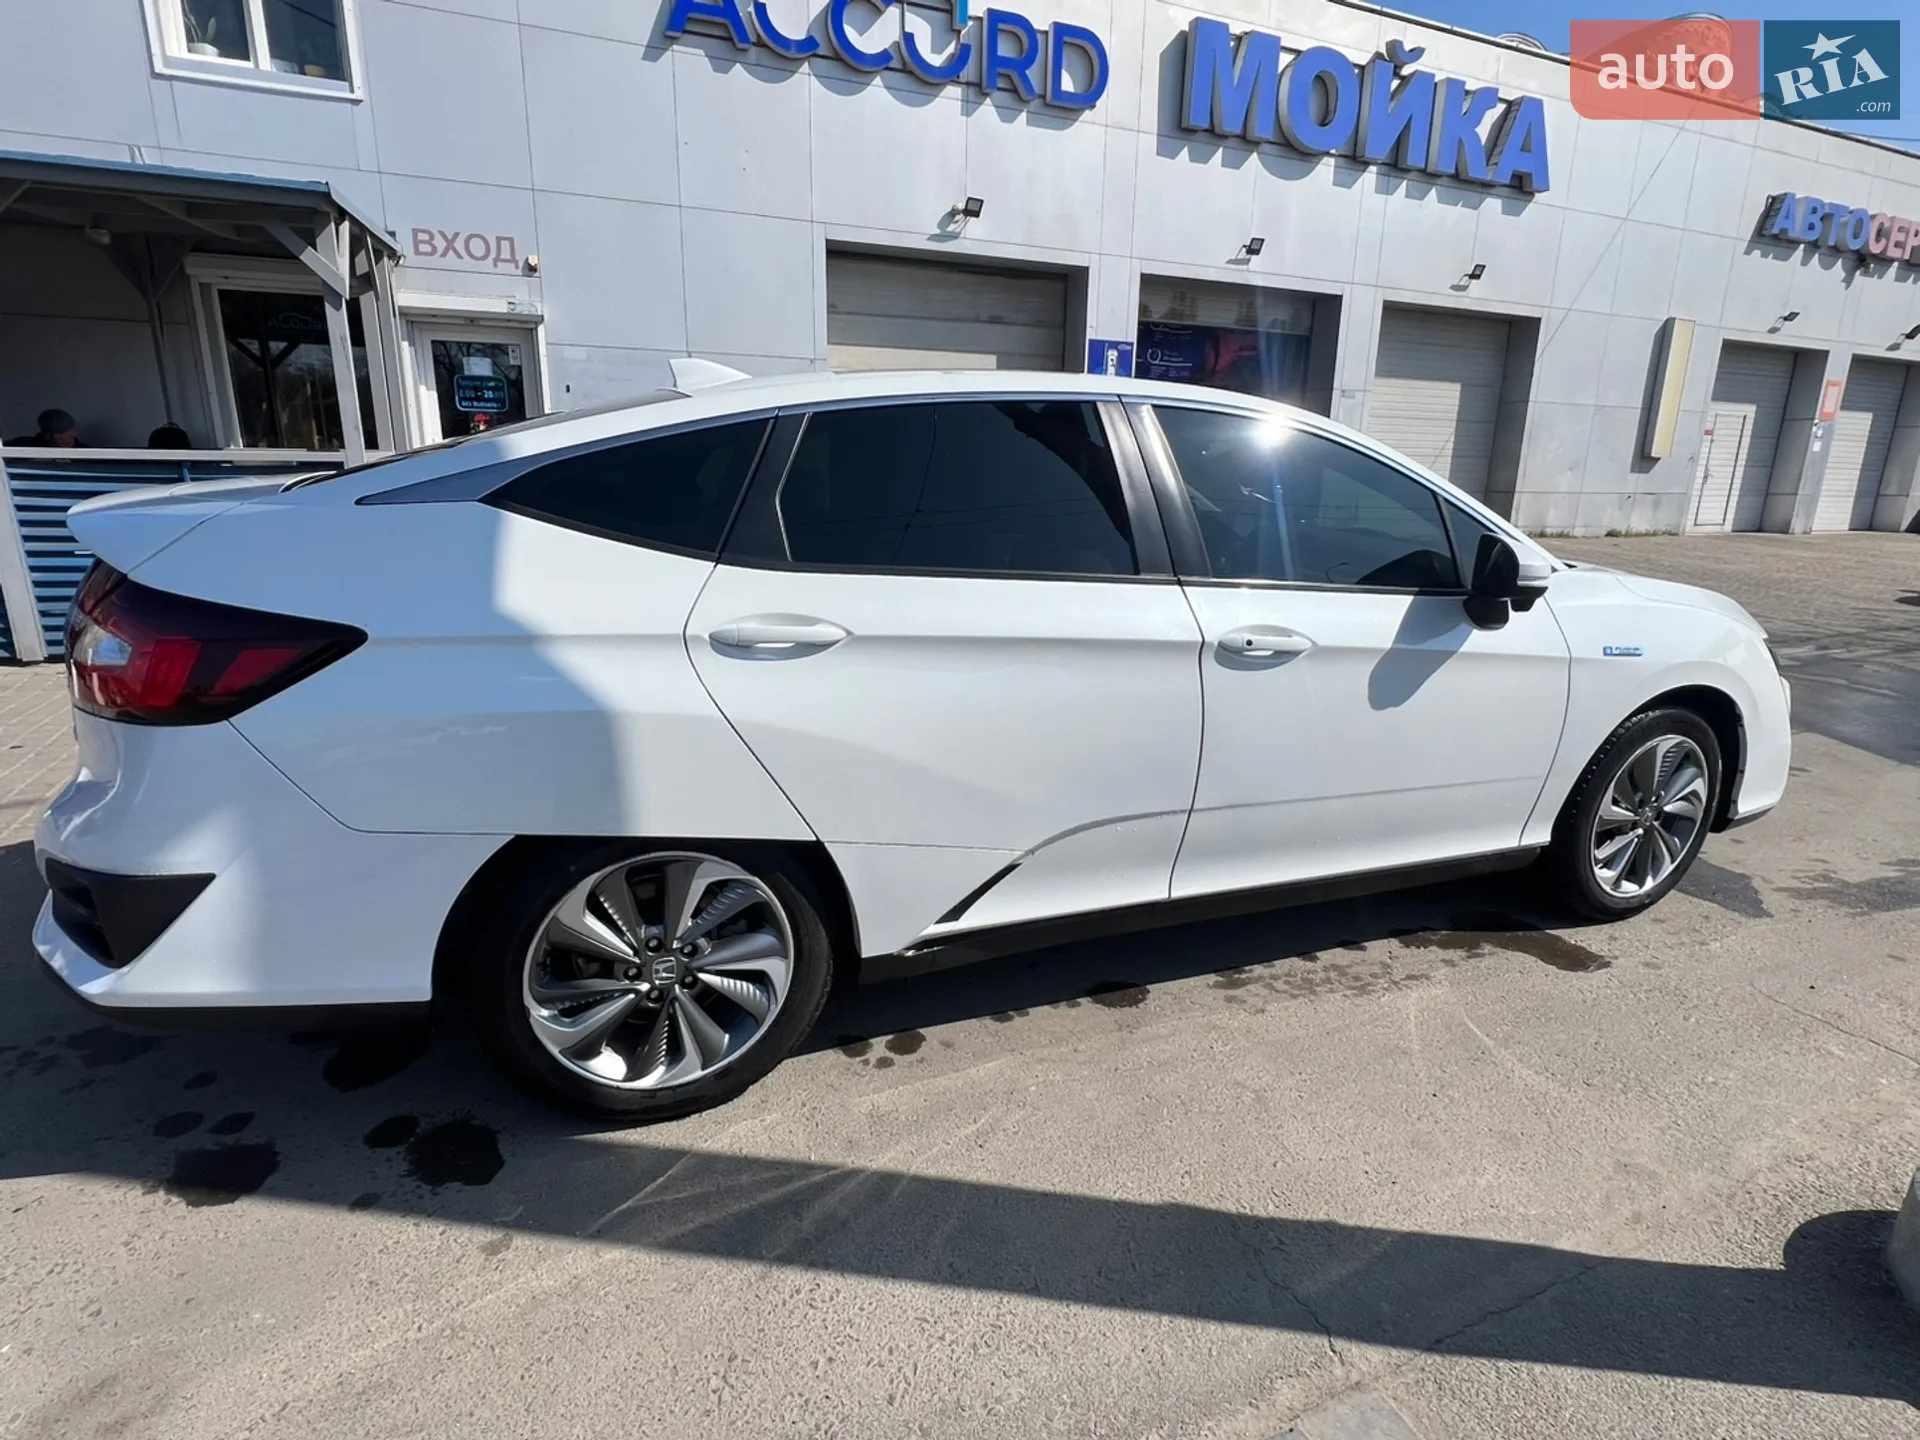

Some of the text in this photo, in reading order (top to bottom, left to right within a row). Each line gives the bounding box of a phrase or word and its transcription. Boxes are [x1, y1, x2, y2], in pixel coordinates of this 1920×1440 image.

[665, 0, 1110, 109] ACCORD
[1183, 16, 1550, 193] МОЙКА
[411, 228, 519, 270] ВХОД
